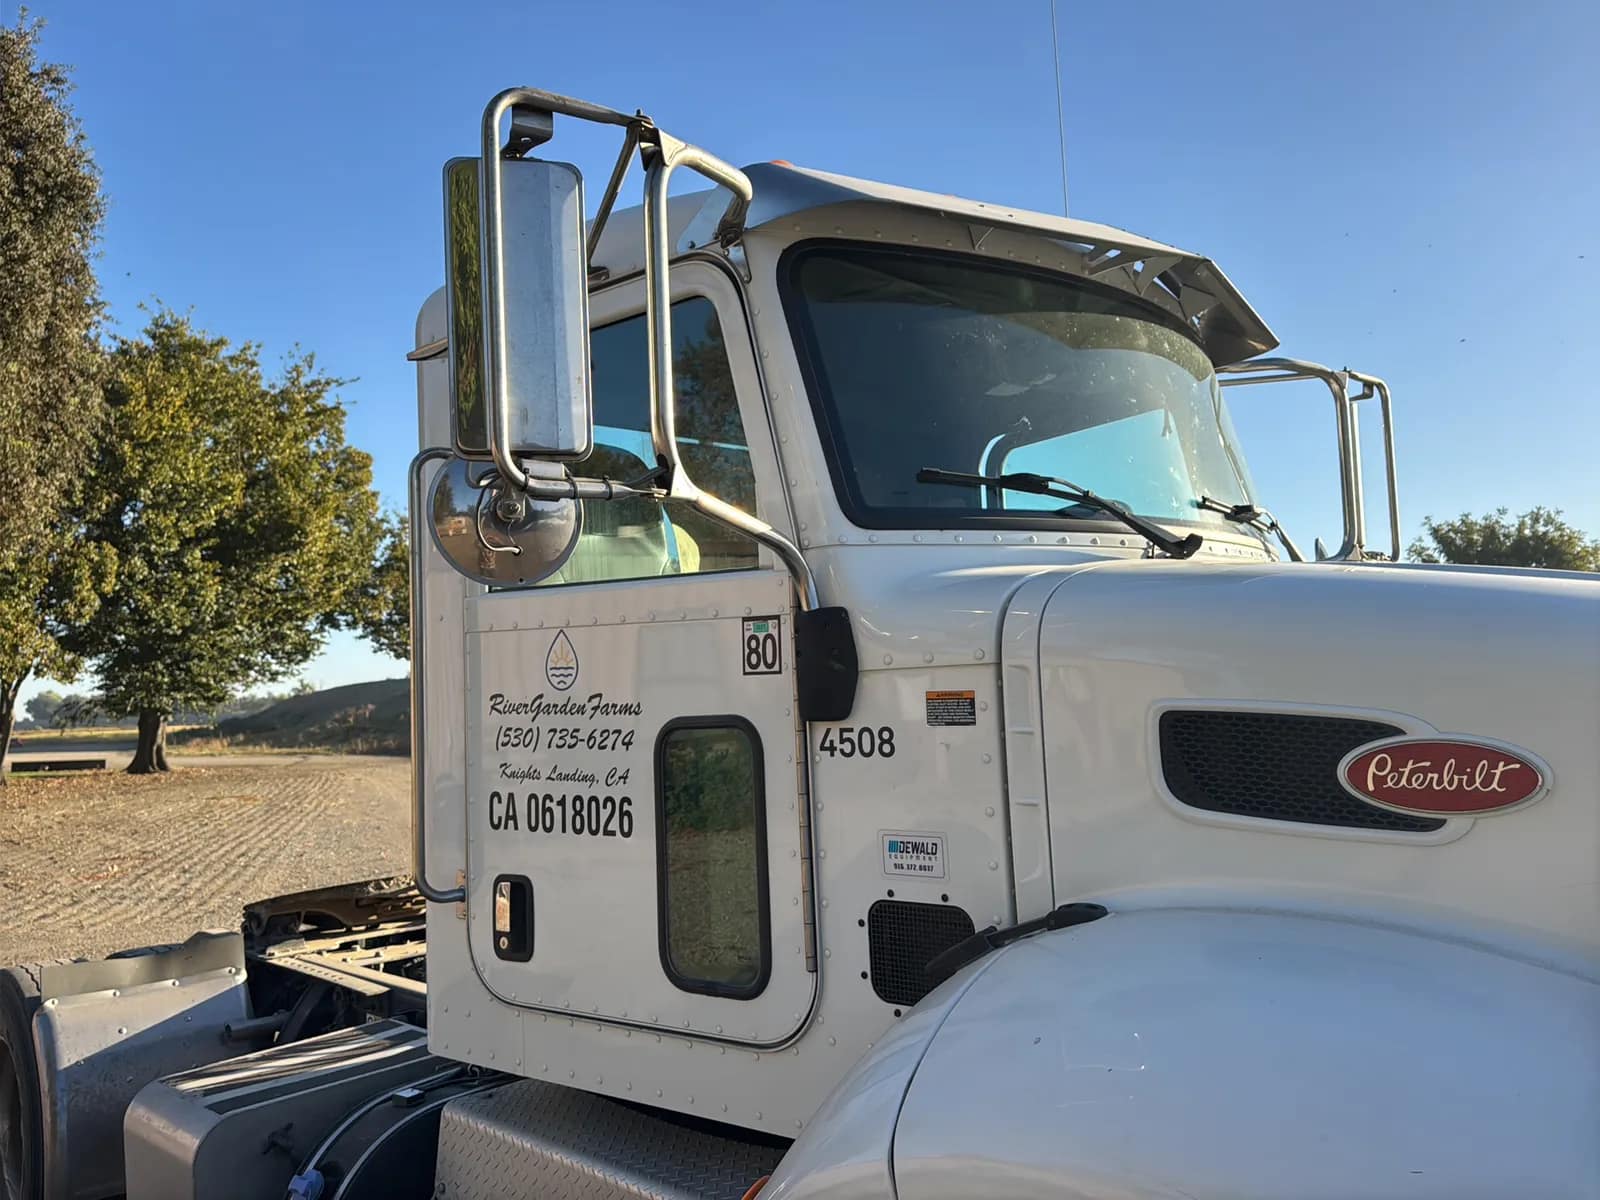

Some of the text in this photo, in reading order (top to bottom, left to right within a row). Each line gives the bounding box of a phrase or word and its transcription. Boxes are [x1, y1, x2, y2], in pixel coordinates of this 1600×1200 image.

[746, 633, 778, 670] 80
[495, 725, 636, 752] (530) 735-6274
[819, 726, 896, 758] 4508
[499, 762, 631, 789] Knights Landing, CA
[1366, 752, 1521, 792] Peterbilt
[489, 790, 634, 839] CA 0618026
[898, 840, 938, 856] DEWALD
